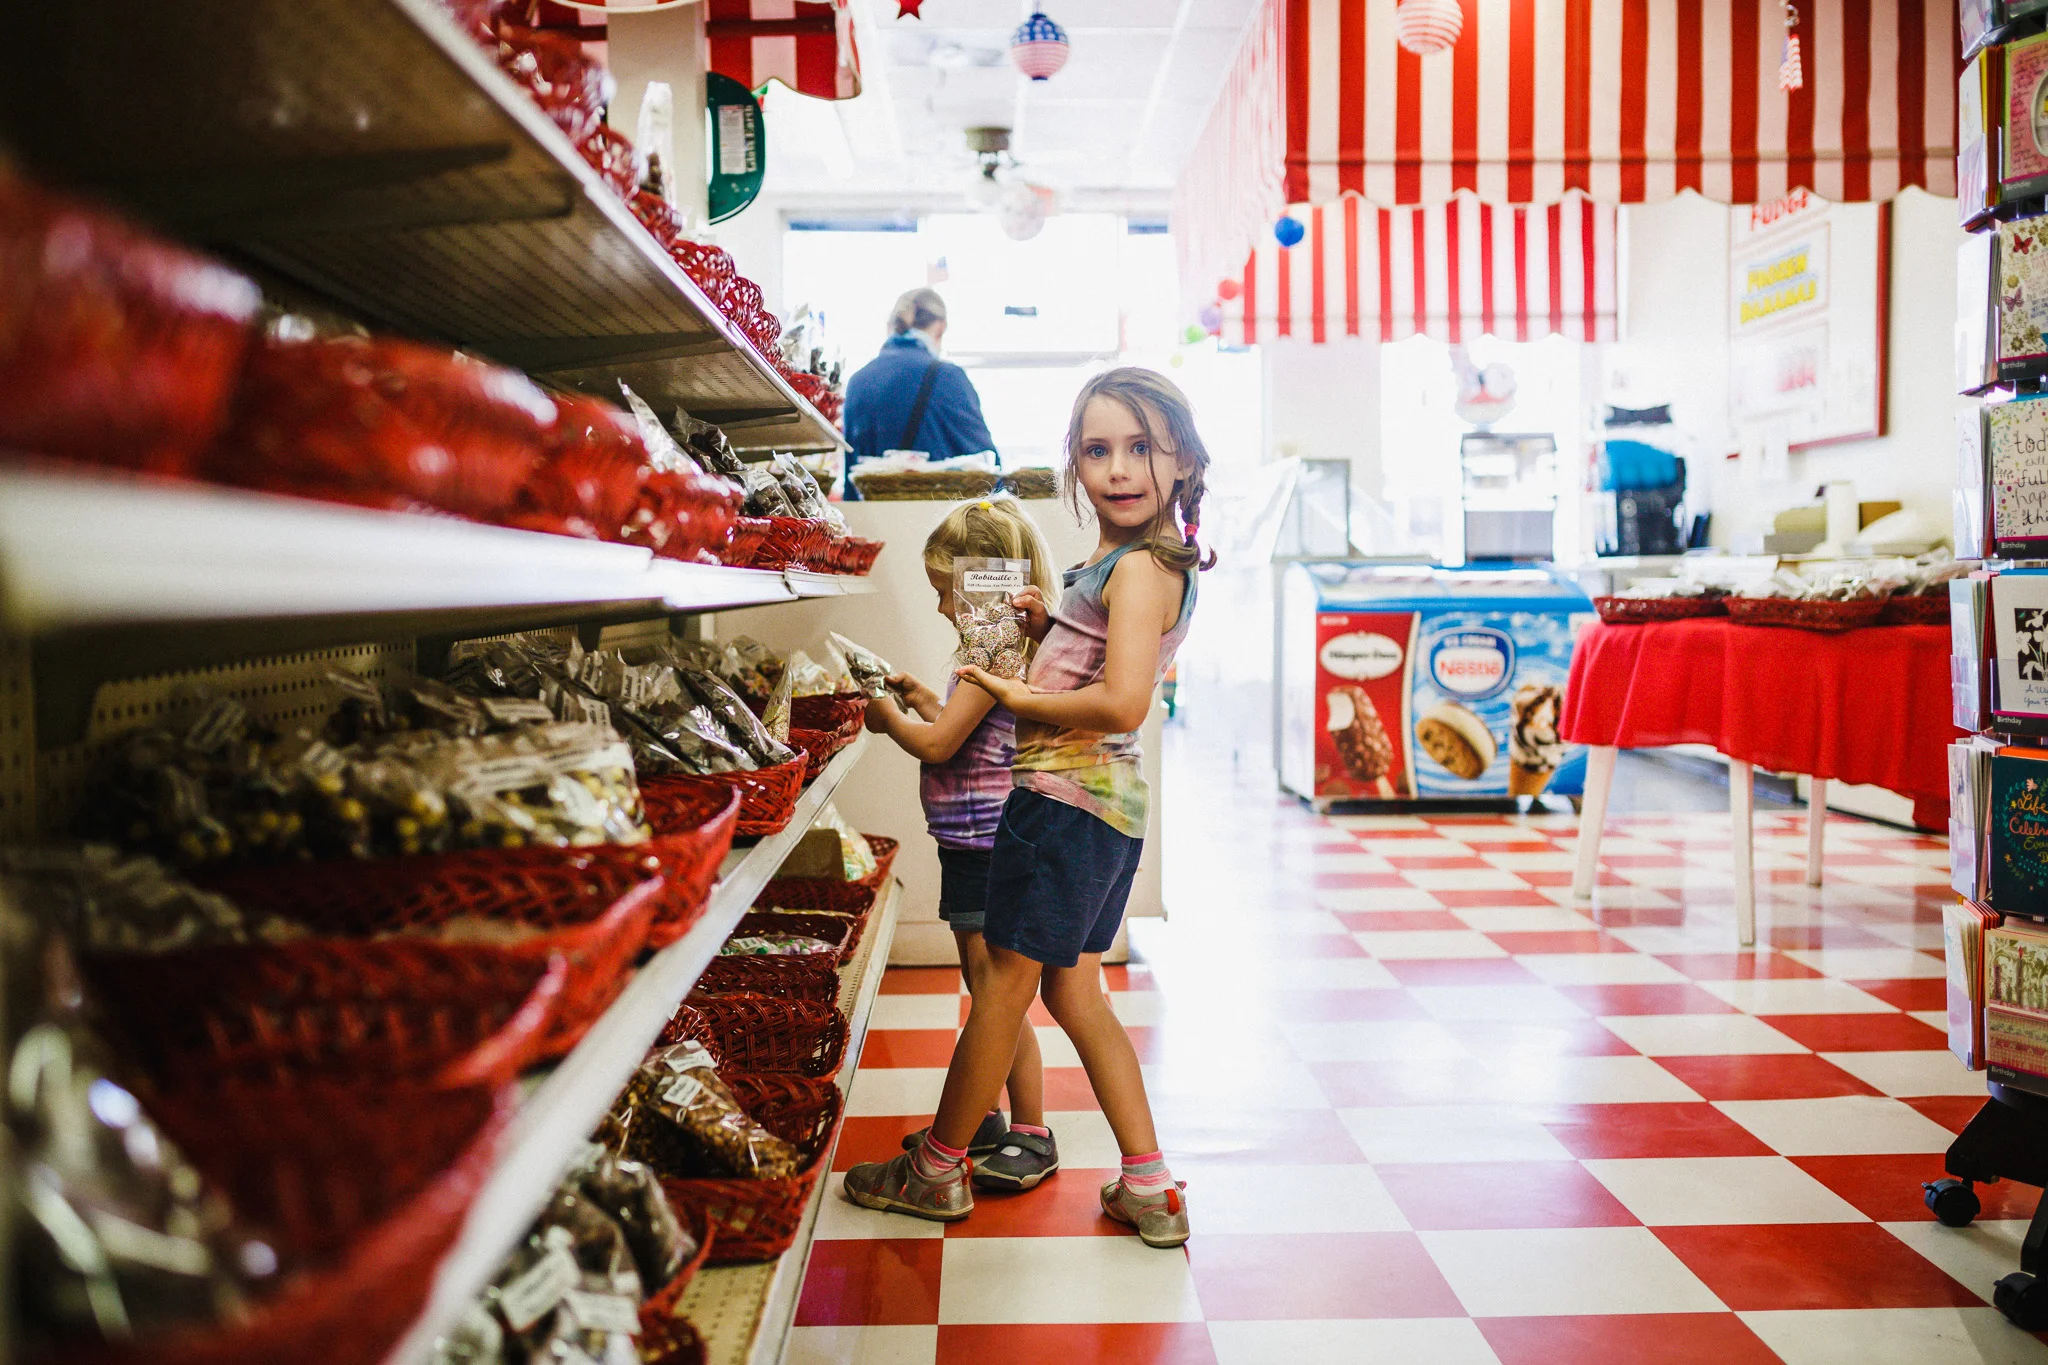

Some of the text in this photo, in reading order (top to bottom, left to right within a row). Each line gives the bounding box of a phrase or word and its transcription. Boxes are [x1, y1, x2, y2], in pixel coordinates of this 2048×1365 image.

[1747, 252, 1808, 294] FROZEN
[2001, 361, 2027, 370] Birthday
[2001, 542, 2027, 550] Birthday
[970, 573, 1018, 581] Robitaille's
[1997, 715, 2022, 726] Birthday
[2017, 790, 2048, 816] Life
[1991, 1065, 2016, 1079] Birthday
